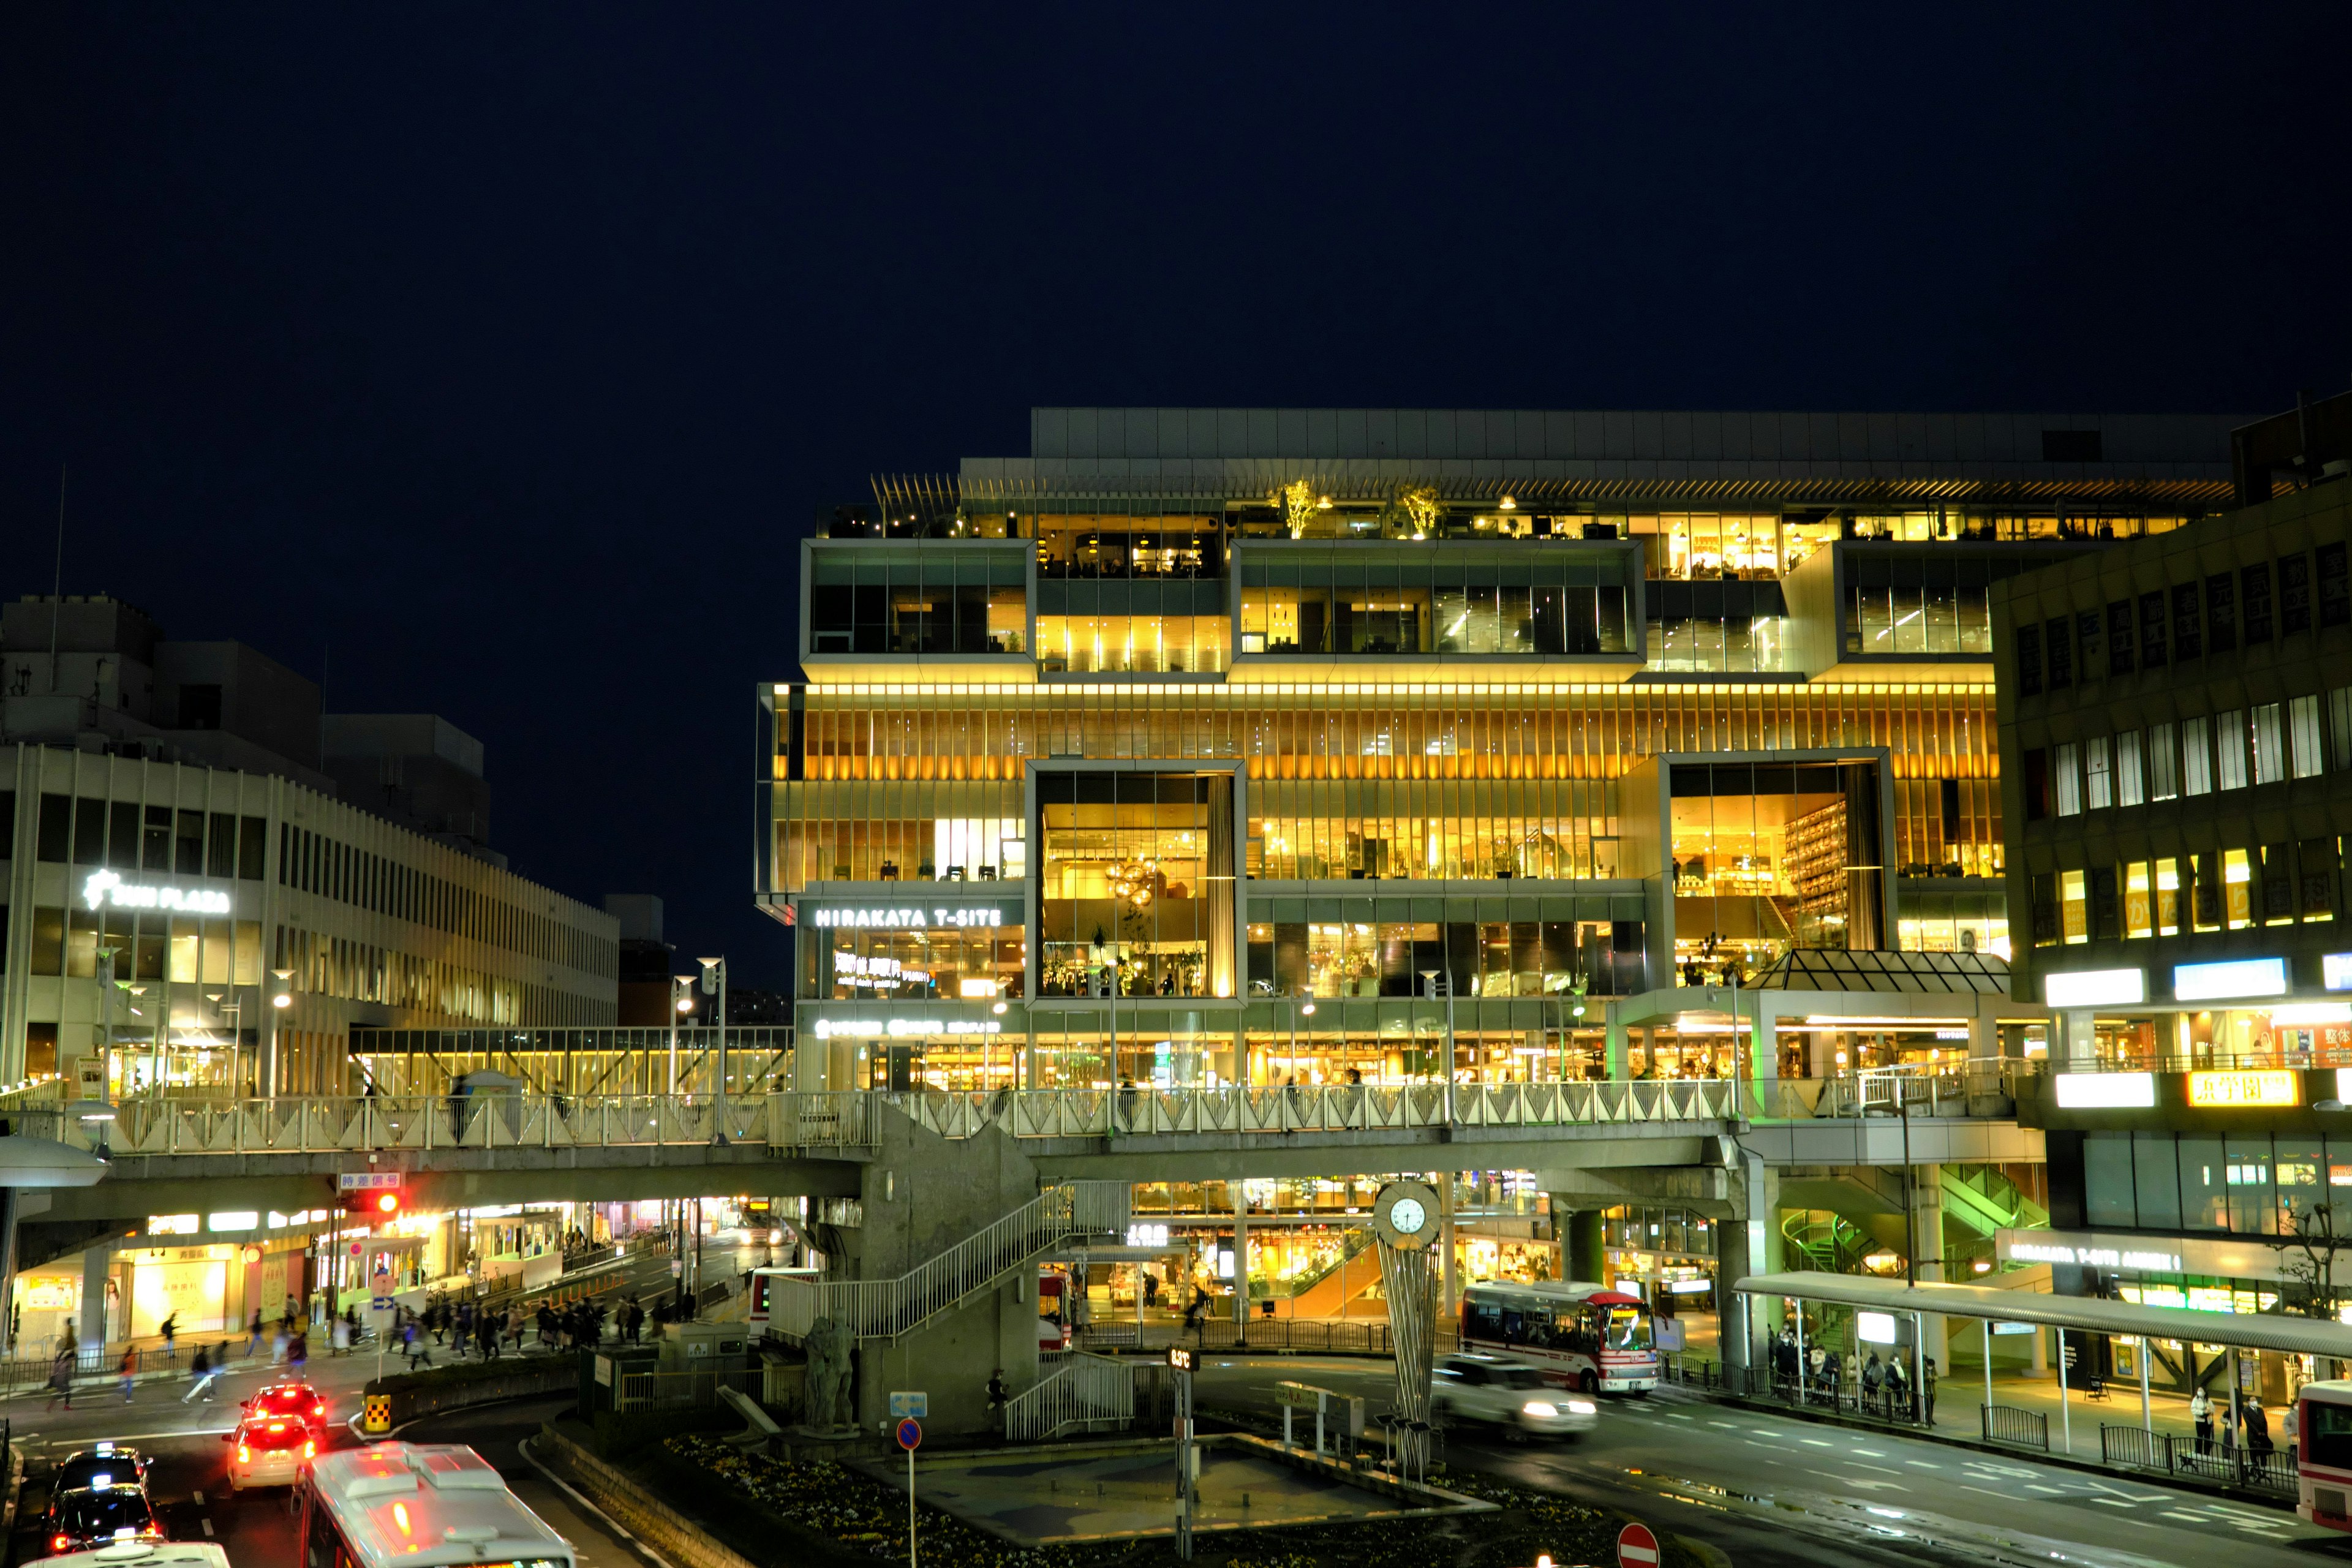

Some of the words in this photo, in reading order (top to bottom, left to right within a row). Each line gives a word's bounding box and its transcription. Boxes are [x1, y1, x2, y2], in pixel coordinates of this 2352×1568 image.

[159, 887, 230, 913] PLAZA
[815, 910, 925, 926] HIRAKATA
[934, 910, 1001, 926] T-SITE
[2325, 1028, 2351, 1044] 整体
[2196, 1076, 2261, 1101] 浜学園
[342, 1175, 398, 1187] 時差信号
[2010, 1244, 2075, 1263] HIRAKATA
[2077, 1248, 2119, 1266] T-SITE
